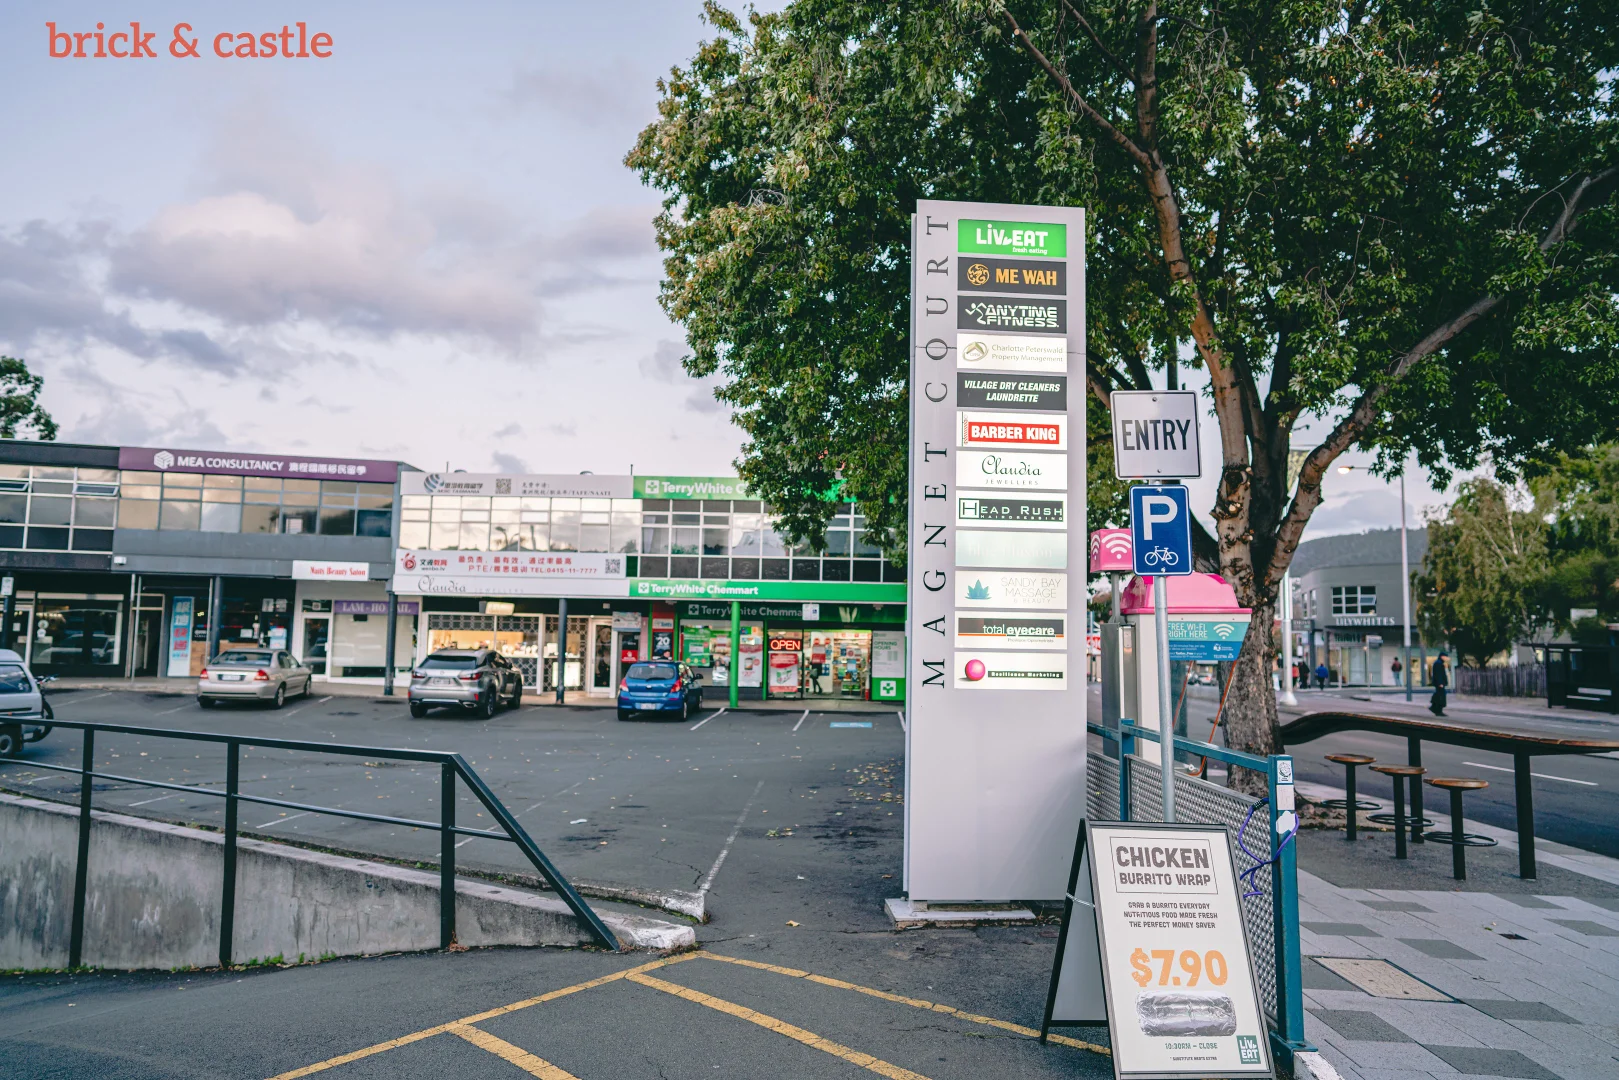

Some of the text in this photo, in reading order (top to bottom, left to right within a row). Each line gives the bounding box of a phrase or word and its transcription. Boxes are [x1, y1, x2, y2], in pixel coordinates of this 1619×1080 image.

[1029, 247, 1048, 255] eating
[996, 268, 1057, 286] ME WAH
[985, 304, 1057, 318] ANYTIME
[992, 344, 1063, 354] Charlotte Peterswald
[992, 354, 1020, 362] Property
[964, 380, 1060, 392] VILLAGE DRY CLEANERS
[986, 393, 1039, 402] LAUNDRETTE
[972, 426, 1056, 440] BARBER KING
[1121, 419, 1191, 450] ENTRY
[922, 216, 949, 689] MAGNET COURT
[178, 456, 284, 471] MEA CONSULTANCY
[982, 455, 1042, 476] Claudia
[662, 482, 733, 496] TerryWhite
[1020, 506, 1062, 516] RUSH
[1142, 496, 1178, 541] P
[418, 575, 466, 592] Claudia
[1001, 577, 1061, 588] SANDY BAY
[650, 584, 758, 595] TerryWhite Chemmart
[1005, 588, 1056, 598] MASSAGE
[1336, 617, 1395, 626] LILYWHITES
[983, 624, 1055, 637] total eyecare
[770, 640, 800, 650] OPEN
[1116, 846, 1209, 868] CHICKEN
[1120, 872, 1210, 886] BURRITO WRAP
[1130, 948, 1228, 987] $7.90
[1241, 1050, 1258, 1058] EAT
